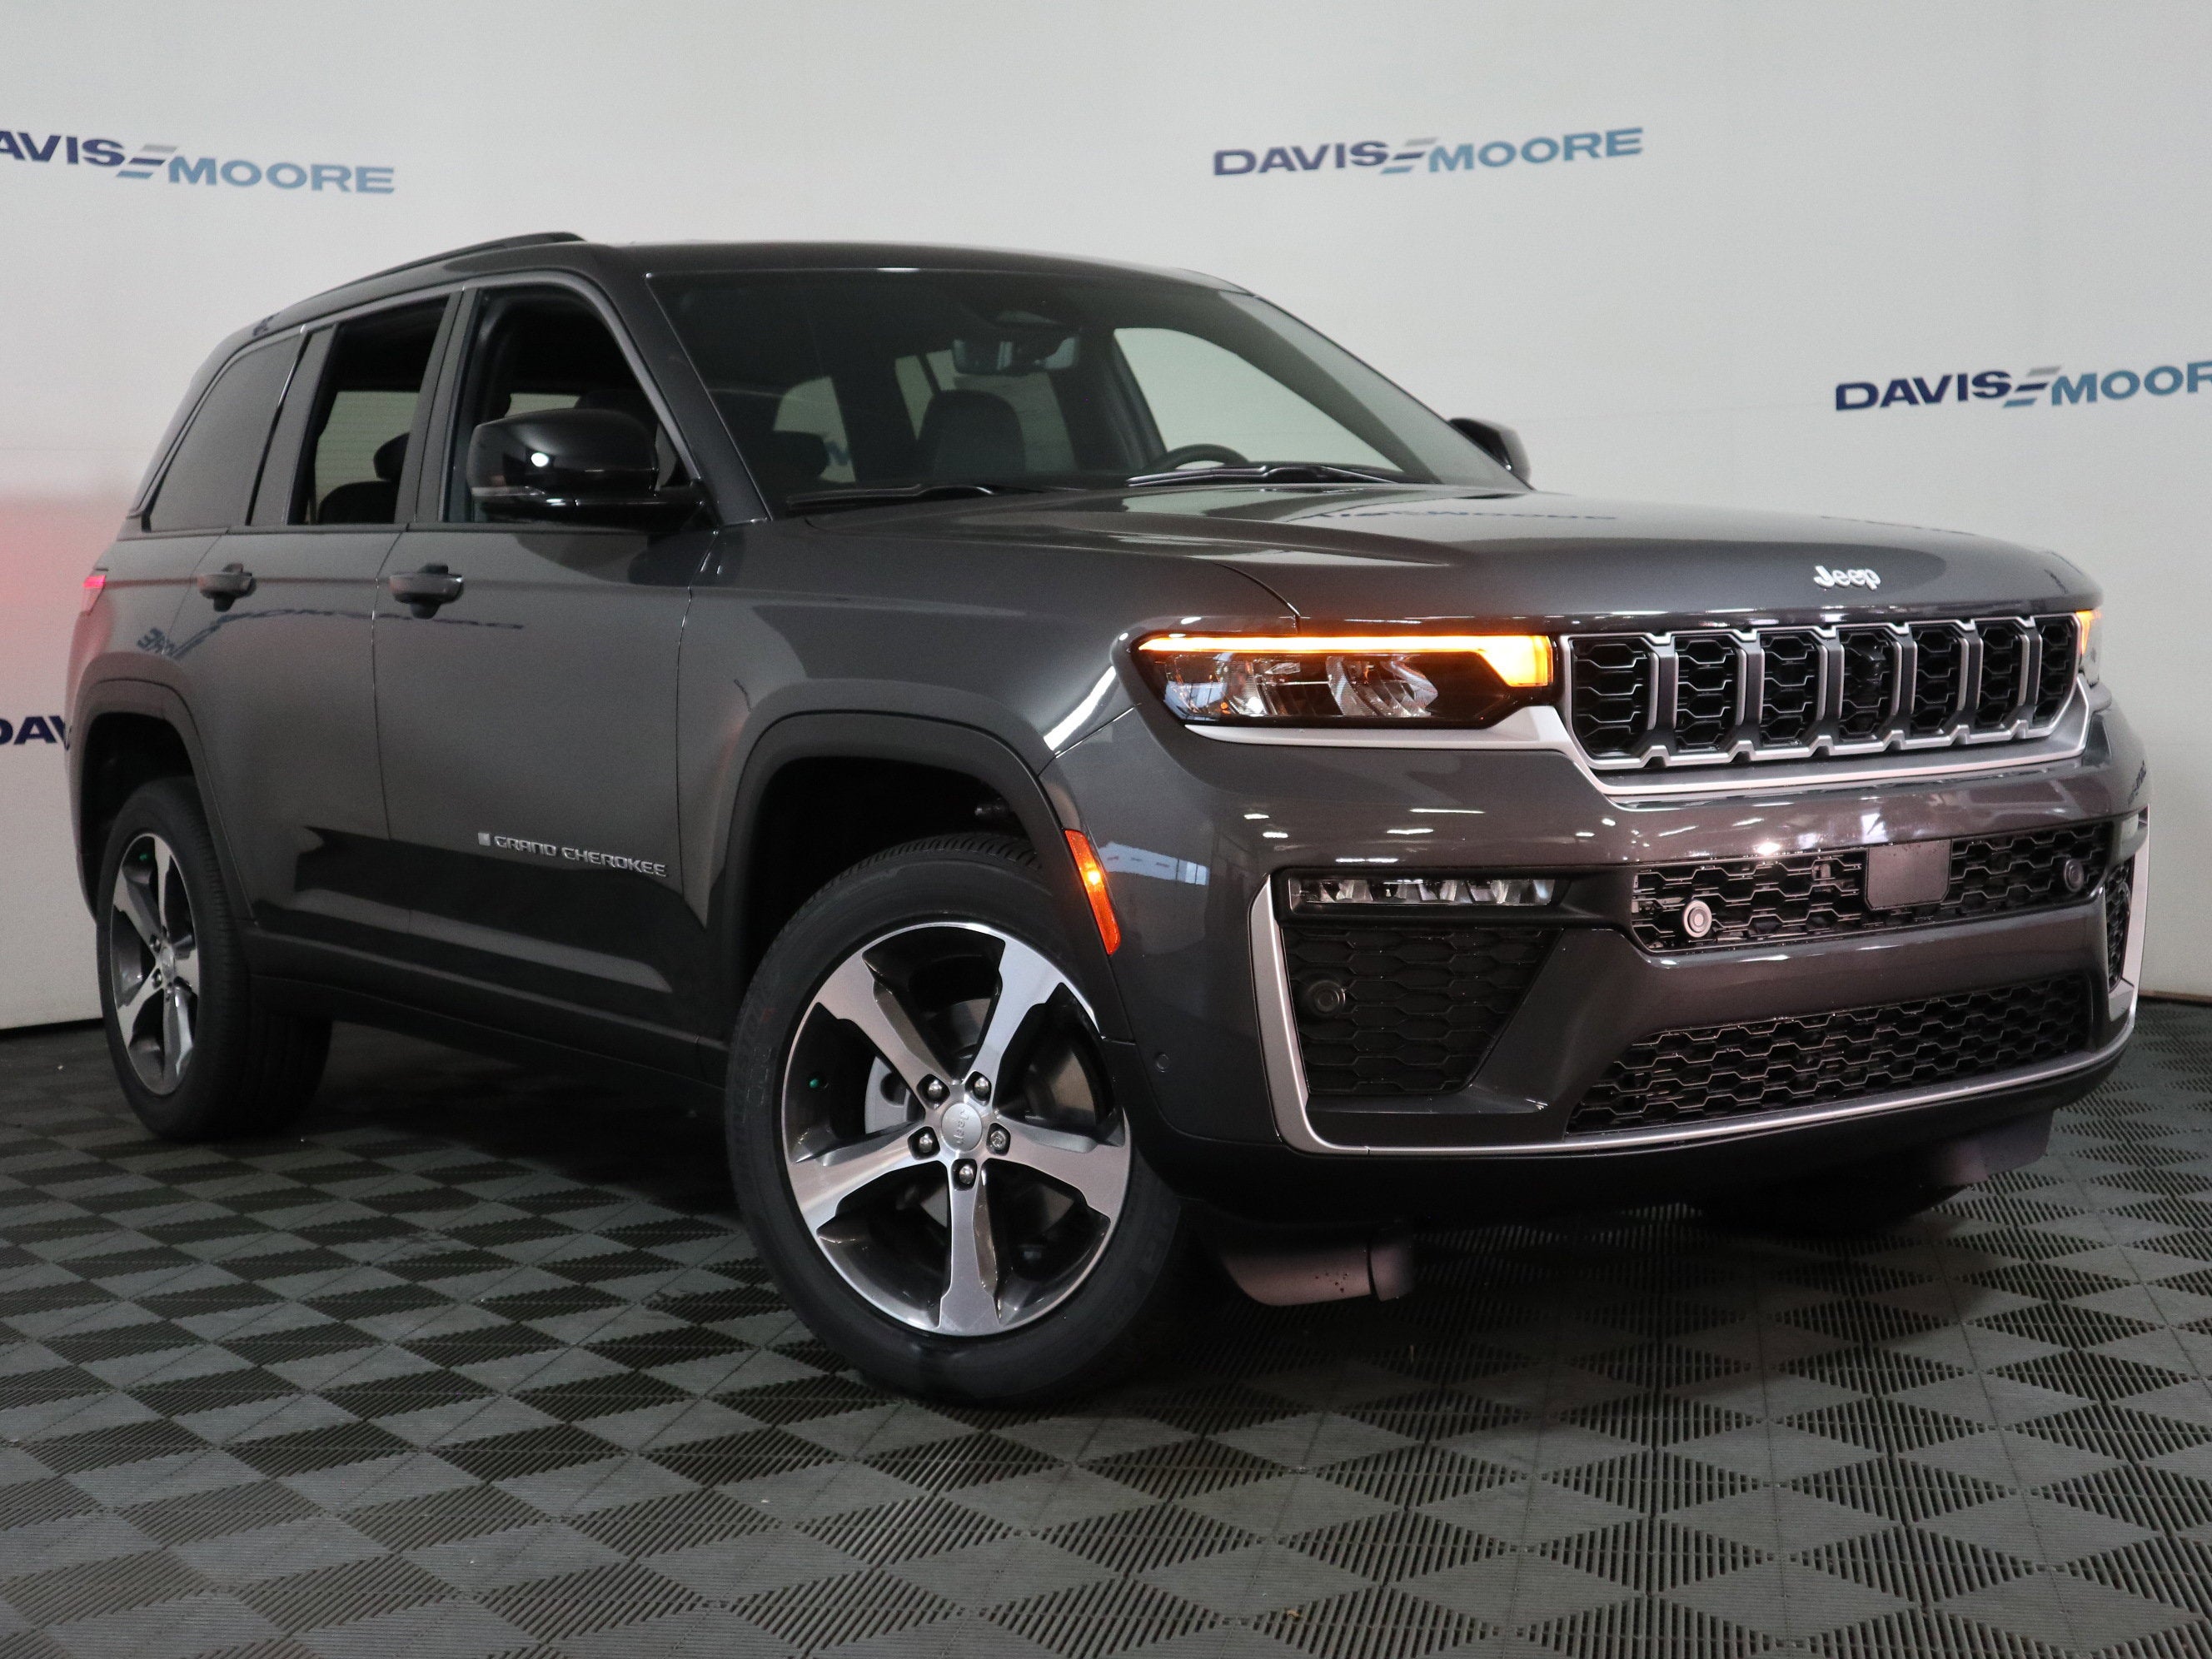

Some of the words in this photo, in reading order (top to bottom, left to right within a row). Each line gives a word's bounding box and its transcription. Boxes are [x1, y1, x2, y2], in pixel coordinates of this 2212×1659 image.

[0, 130, 126, 167] AVIS
[168, 156, 396, 195] MOORE
[1213, 140, 1389, 177] DAVIS
[1428, 127, 1644, 173] MOORE
[1835, 370, 2012, 412] DAVIS
[2051, 360, 2212, 407] MOOR
[1813, 565, 1881, 590] Jeep
[494, 834, 557, 858] GRAND
[561, 846, 667, 878] CHEROKEE
